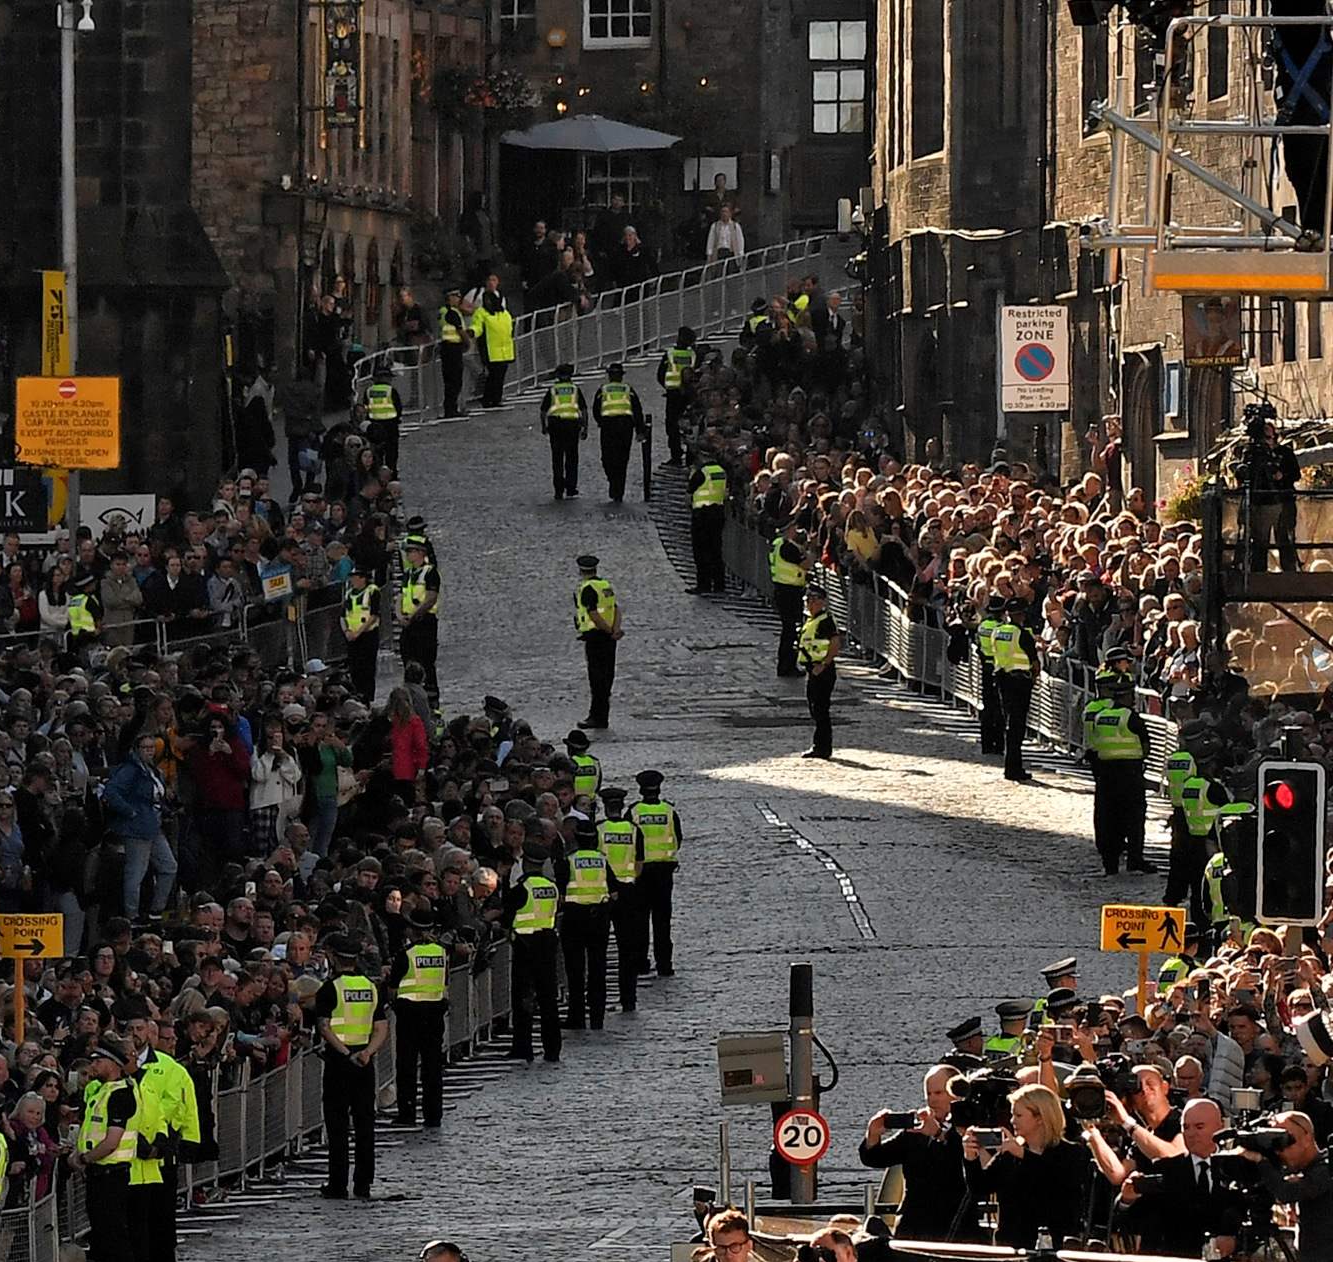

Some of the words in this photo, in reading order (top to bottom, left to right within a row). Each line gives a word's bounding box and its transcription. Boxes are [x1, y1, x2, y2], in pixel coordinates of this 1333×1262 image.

[1008, 308, 1062, 318] Restricted
[1016, 319, 1054, 330] parking
[1016, 330, 1054, 341] ZONE
[22, 409, 56, 418] CASTLE
[58, 409, 112, 418] ESPLANADE
[24, 418, 45, 427] CAR
[46, 418, 70, 427] PARK
[72, 418, 110, 427] CLOSED
[20, 429, 54, 438] EXCEPT
[56, 429, 114, 438] AUTHORISED
[44, 438, 89, 446] VEHICLES
[23, 448, 81, 457] BUSINESSES
[84, 448, 109, 457] OPEN
[4, 490, 26, 517] K
[640, 815, 667, 824] POLICE
[605, 834, 632, 844] POLICE
[576, 859, 604, 868] POLICE
[1104, 907, 1160, 920] CROSSING
[3, 916, 58, 926] CROSSING
[1116, 921, 1146, 932] POINT
[13, 928, 45, 937] POINT
[416, 957, 444, 967] POLICE
[345, 991, 373, 1001] POLICE
[783, 1126, 822, 1148] 20
